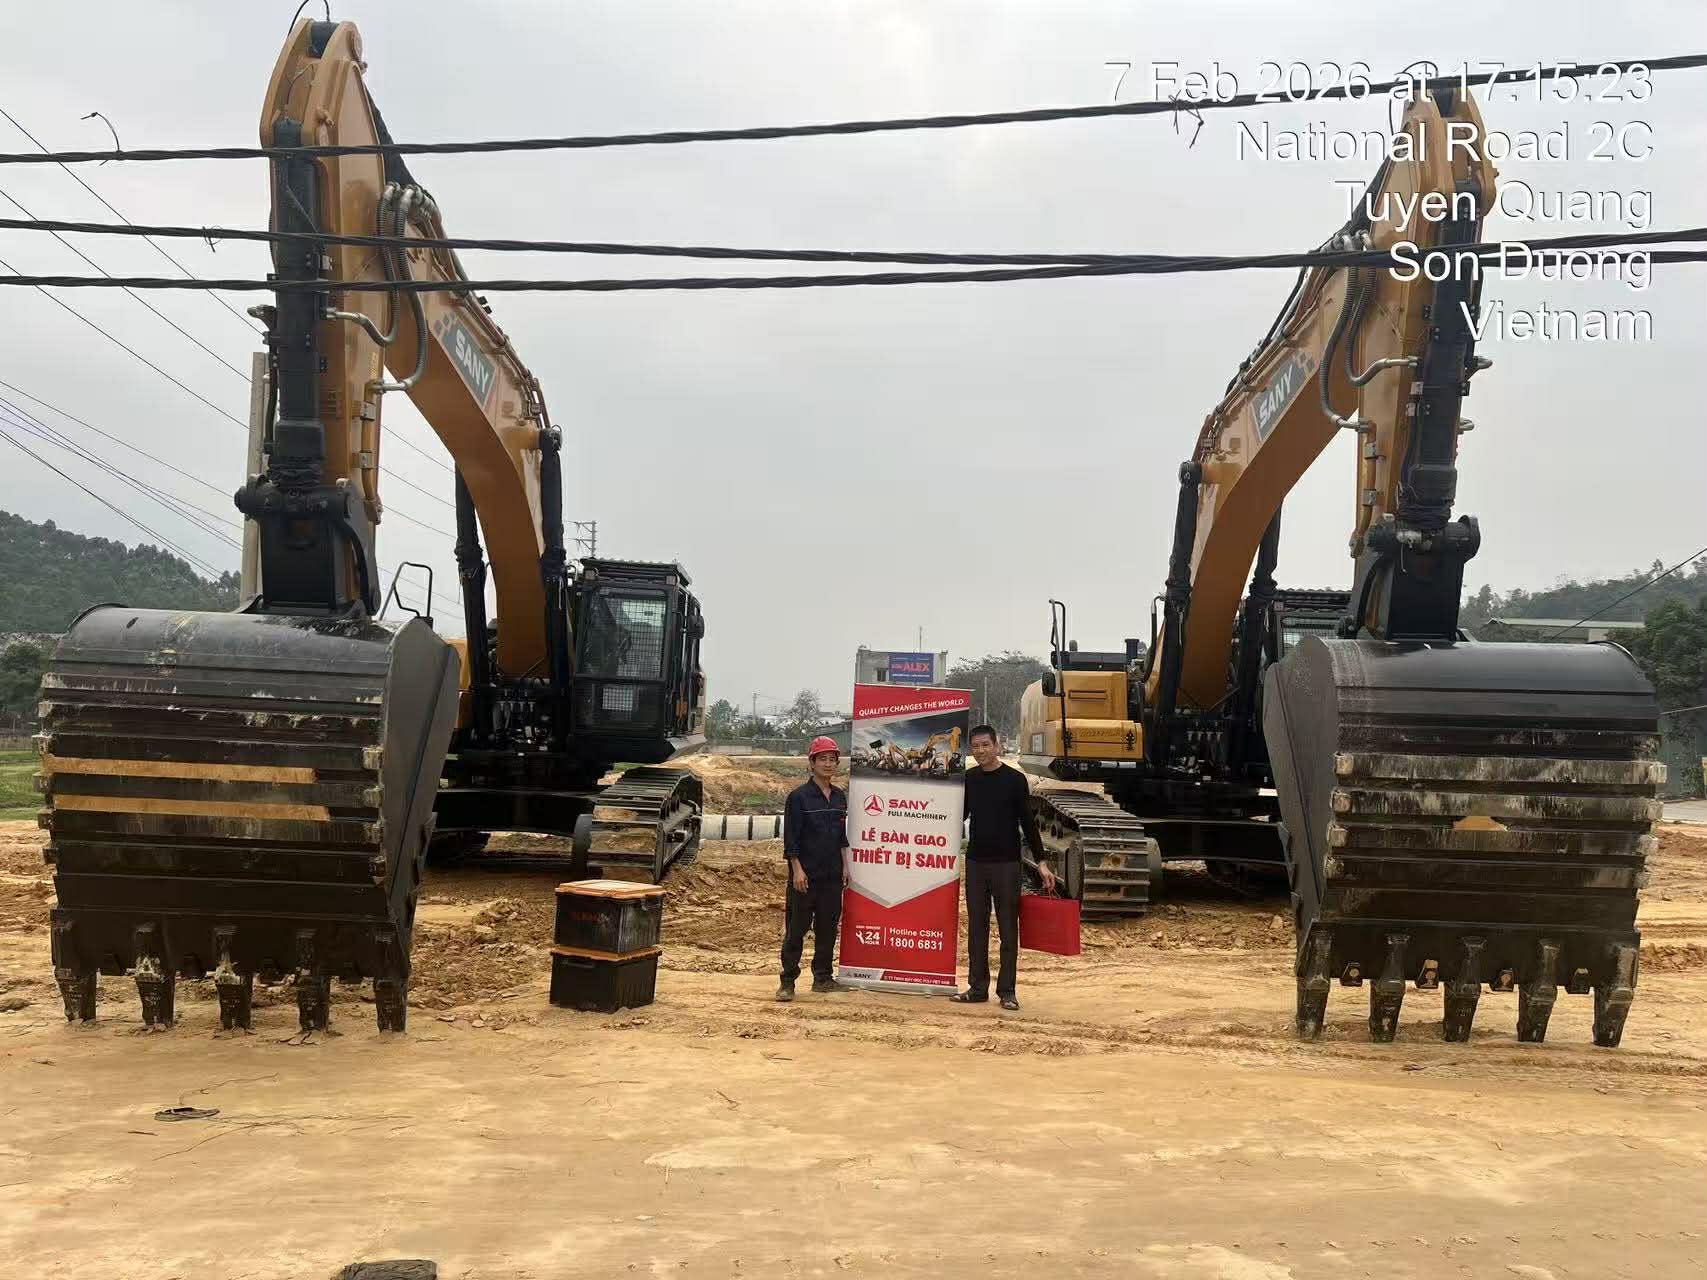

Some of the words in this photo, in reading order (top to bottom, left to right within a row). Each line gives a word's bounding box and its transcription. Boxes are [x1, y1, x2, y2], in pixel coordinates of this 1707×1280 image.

[455, 329, 488, 392] SANY
[1259, 364, 1293, 428] SANY
[859, 706, 890, 716] QUALITY
[890, 704, 922, 712] CHANGES
[938, 699, 964, 707] WORLD
[889, 799, 929, 810] SANY
[862, 827, 876, 841] LỄ
[881, 830, 908, 843] BÀN
[914, 834, 946, 847] GIAO
[852, 846, 892, 863] THIẾT
[896, 852, 910, 869] BỊ
[916, 853, 956, 869] SANY
[865, 932, 880, 940] 24
[890, 927, 917, 936] Hotline
[920, 930, 943, 938] CSKH
[890, 938, 914, 948] 1800
[918, 940, 943, 950] 6831
